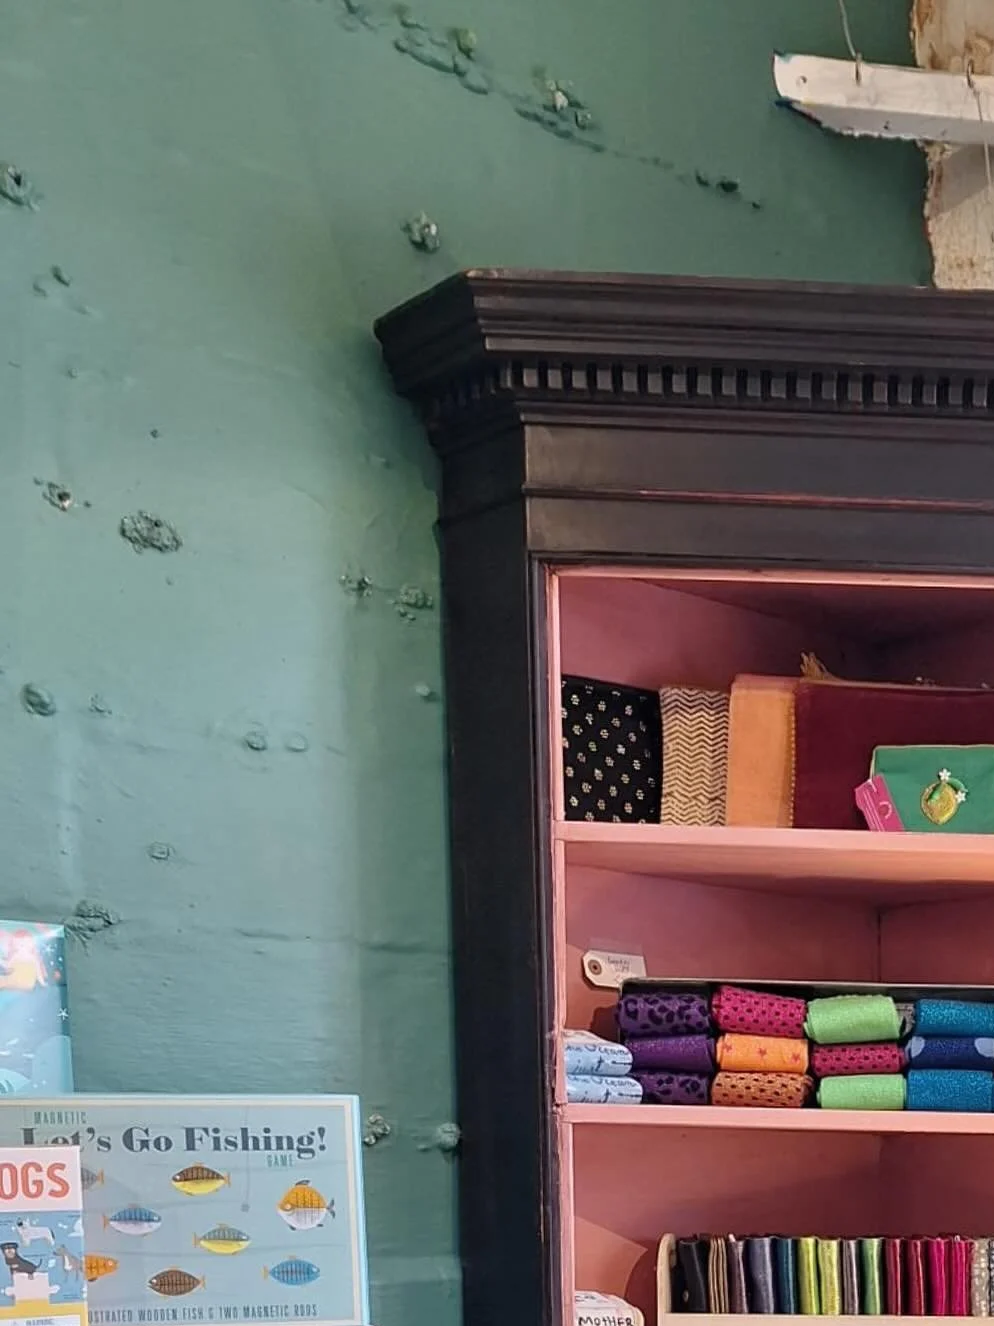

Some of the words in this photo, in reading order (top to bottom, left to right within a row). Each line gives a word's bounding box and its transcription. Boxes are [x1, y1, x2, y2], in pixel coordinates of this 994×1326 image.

[34, 1111, 87, 1125] MAGNETIC
[20, 1127, 111, 1151] Let's
[122, 1126, 173, 1152] Go
[183, 1126, 327, 1160] Fishing!
[266, 1154, 295, 1167] GAME
[138, 1308, 178, 1322] WOODEN
[182, 1307, 204, 1321] FISH
[218, 1306, 239, 1319] TWO
[242, 1304, 290, 1319] MAGNETIC
[294, 1303, 319, 1316] RODS
